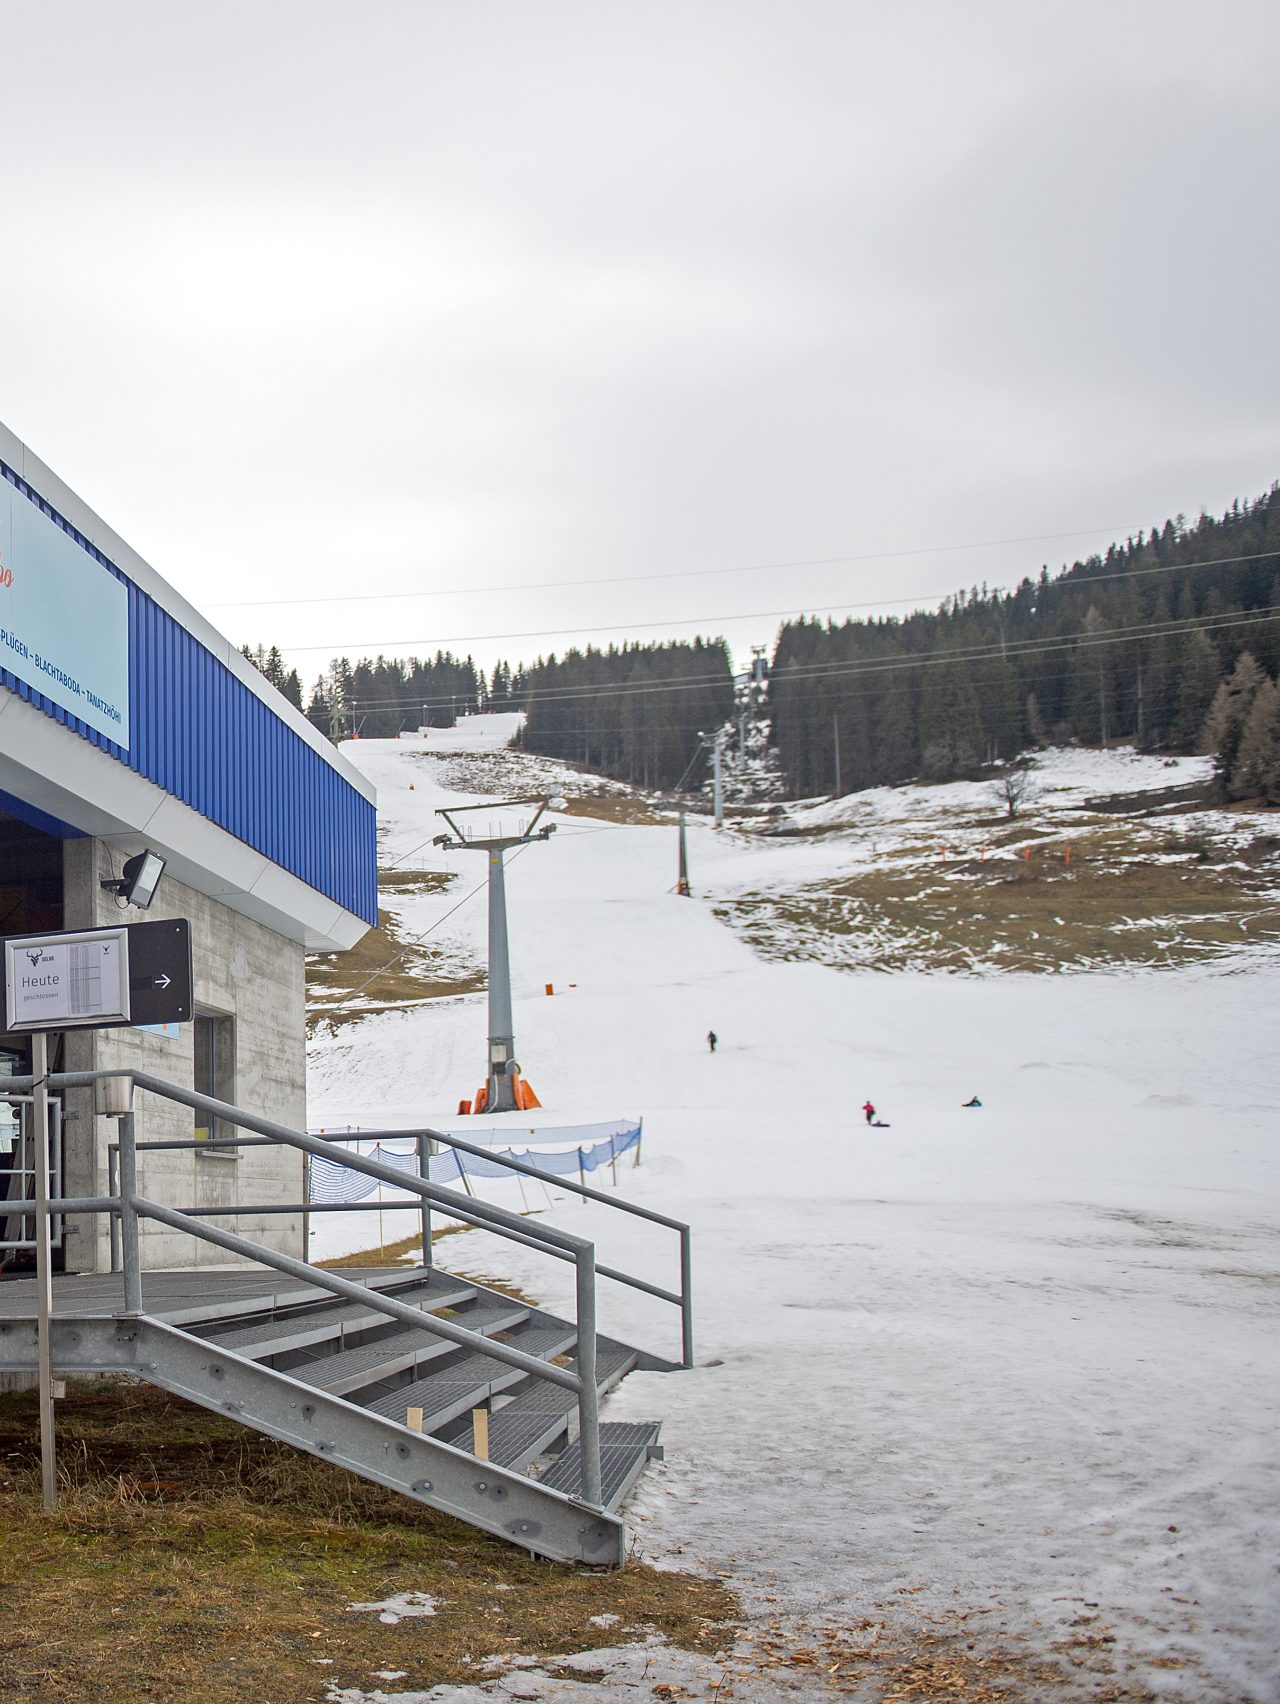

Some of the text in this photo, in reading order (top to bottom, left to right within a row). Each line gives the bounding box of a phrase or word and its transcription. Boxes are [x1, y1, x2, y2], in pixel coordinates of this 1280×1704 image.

[35, 654, 80, 696] BLACHTABODA
[22, 974, 59, 988] Heute
[24, 992, 59, 1002] geschlossen
